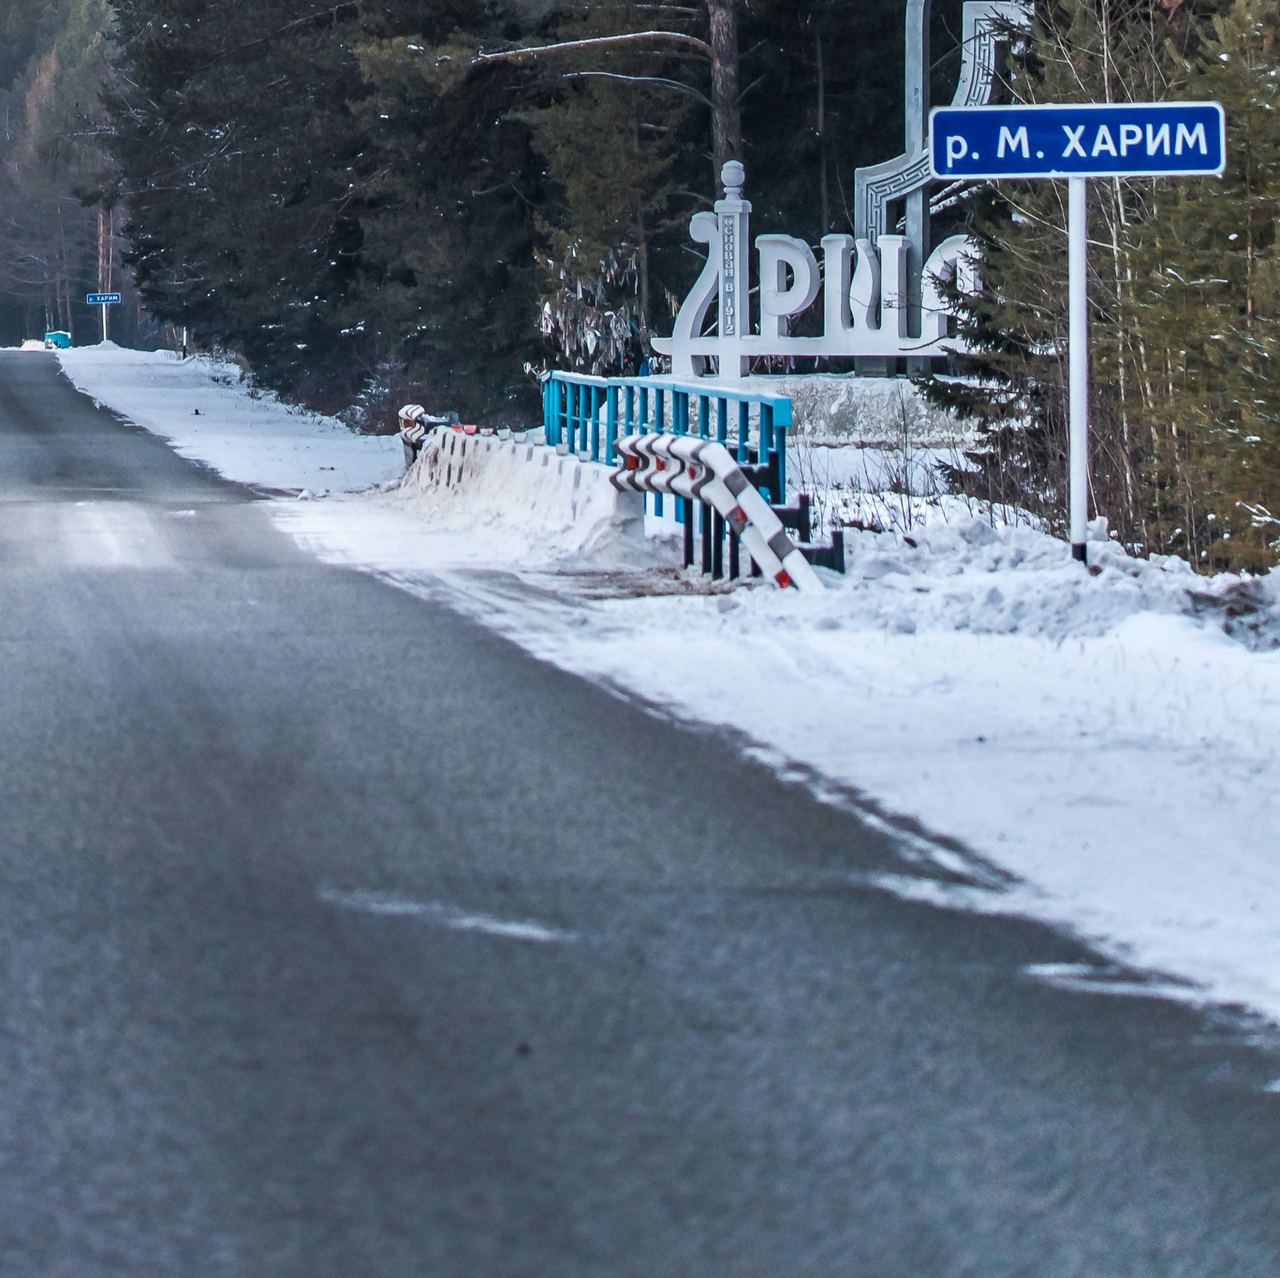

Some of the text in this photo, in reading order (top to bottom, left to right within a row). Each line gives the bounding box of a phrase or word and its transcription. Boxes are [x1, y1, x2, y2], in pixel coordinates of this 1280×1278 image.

[945, 122, 1208, 169] р. М. ХАРИМ
[724, 298, 734, 334] 1912
